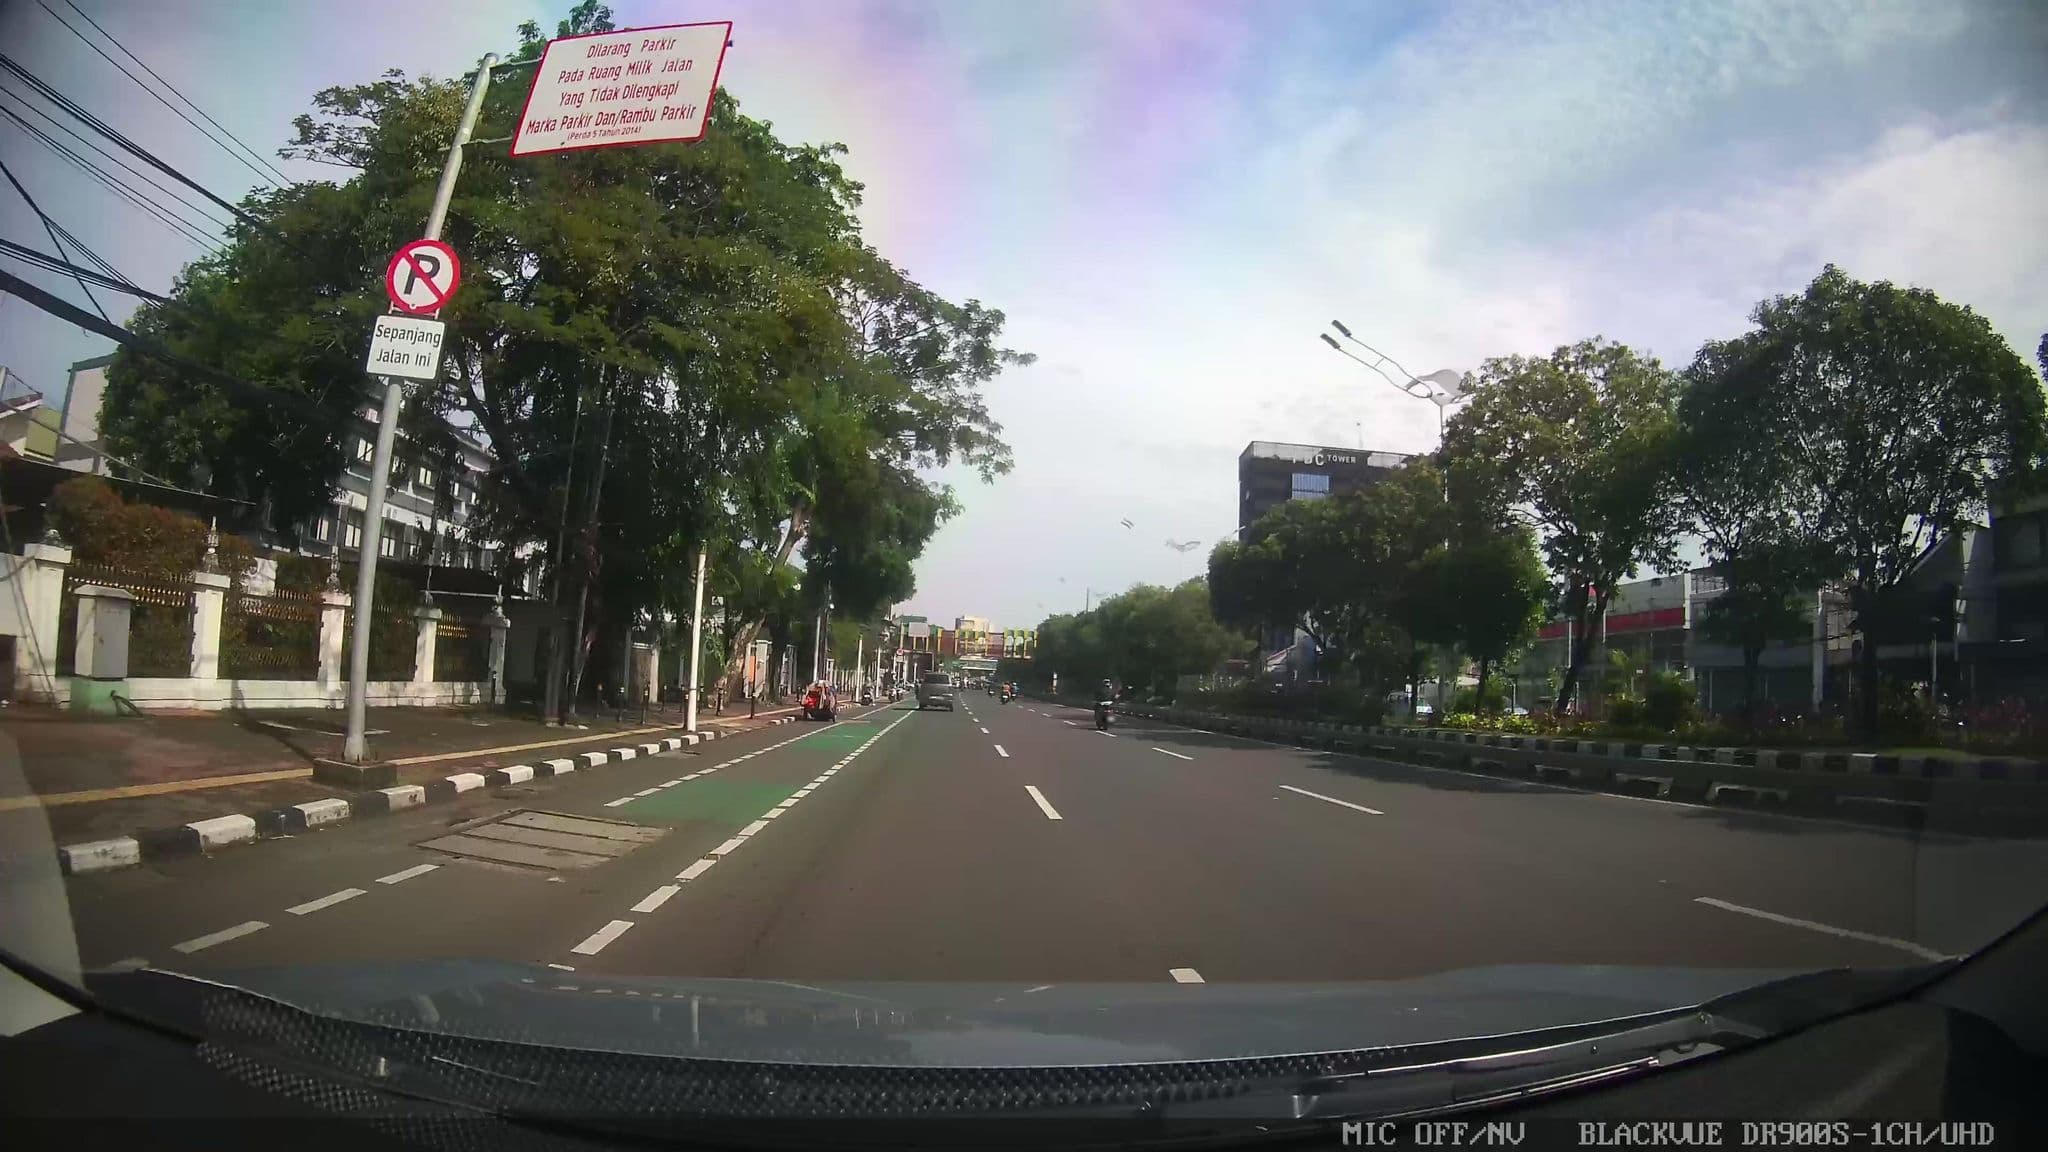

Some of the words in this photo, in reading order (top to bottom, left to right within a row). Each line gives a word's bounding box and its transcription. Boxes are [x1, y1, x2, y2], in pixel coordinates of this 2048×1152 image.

[588, 41, 631, 58] Dilarang
[640, 38, 677, 52] Parkir
[557, 69, 583, 84] Pada
[588, 66, 621, 82] Ruang
[626, 62, 652, 76] Milik
[661, 59, 693, 73] Jalan
[559, 91, 584, 108] Yang
[589, 88, 619, 103] Tidak
[622, 80, 679, 102] Dilengkapi
[526, 119, 557, 135] Marka
[560, 114, 593, 131] Parkir
[595, 108, 656, 128] Dan/Rambu
[660, 105, 696, 121] Parkir
[599, 128, 620, 137] Tahun
[375, 324, 441, 348] Sepanjang
[376, 348, 410, 364] Jalan
[415, 352, 431, 367] Ini
[1327, 454, 1356, 464] TOWER
